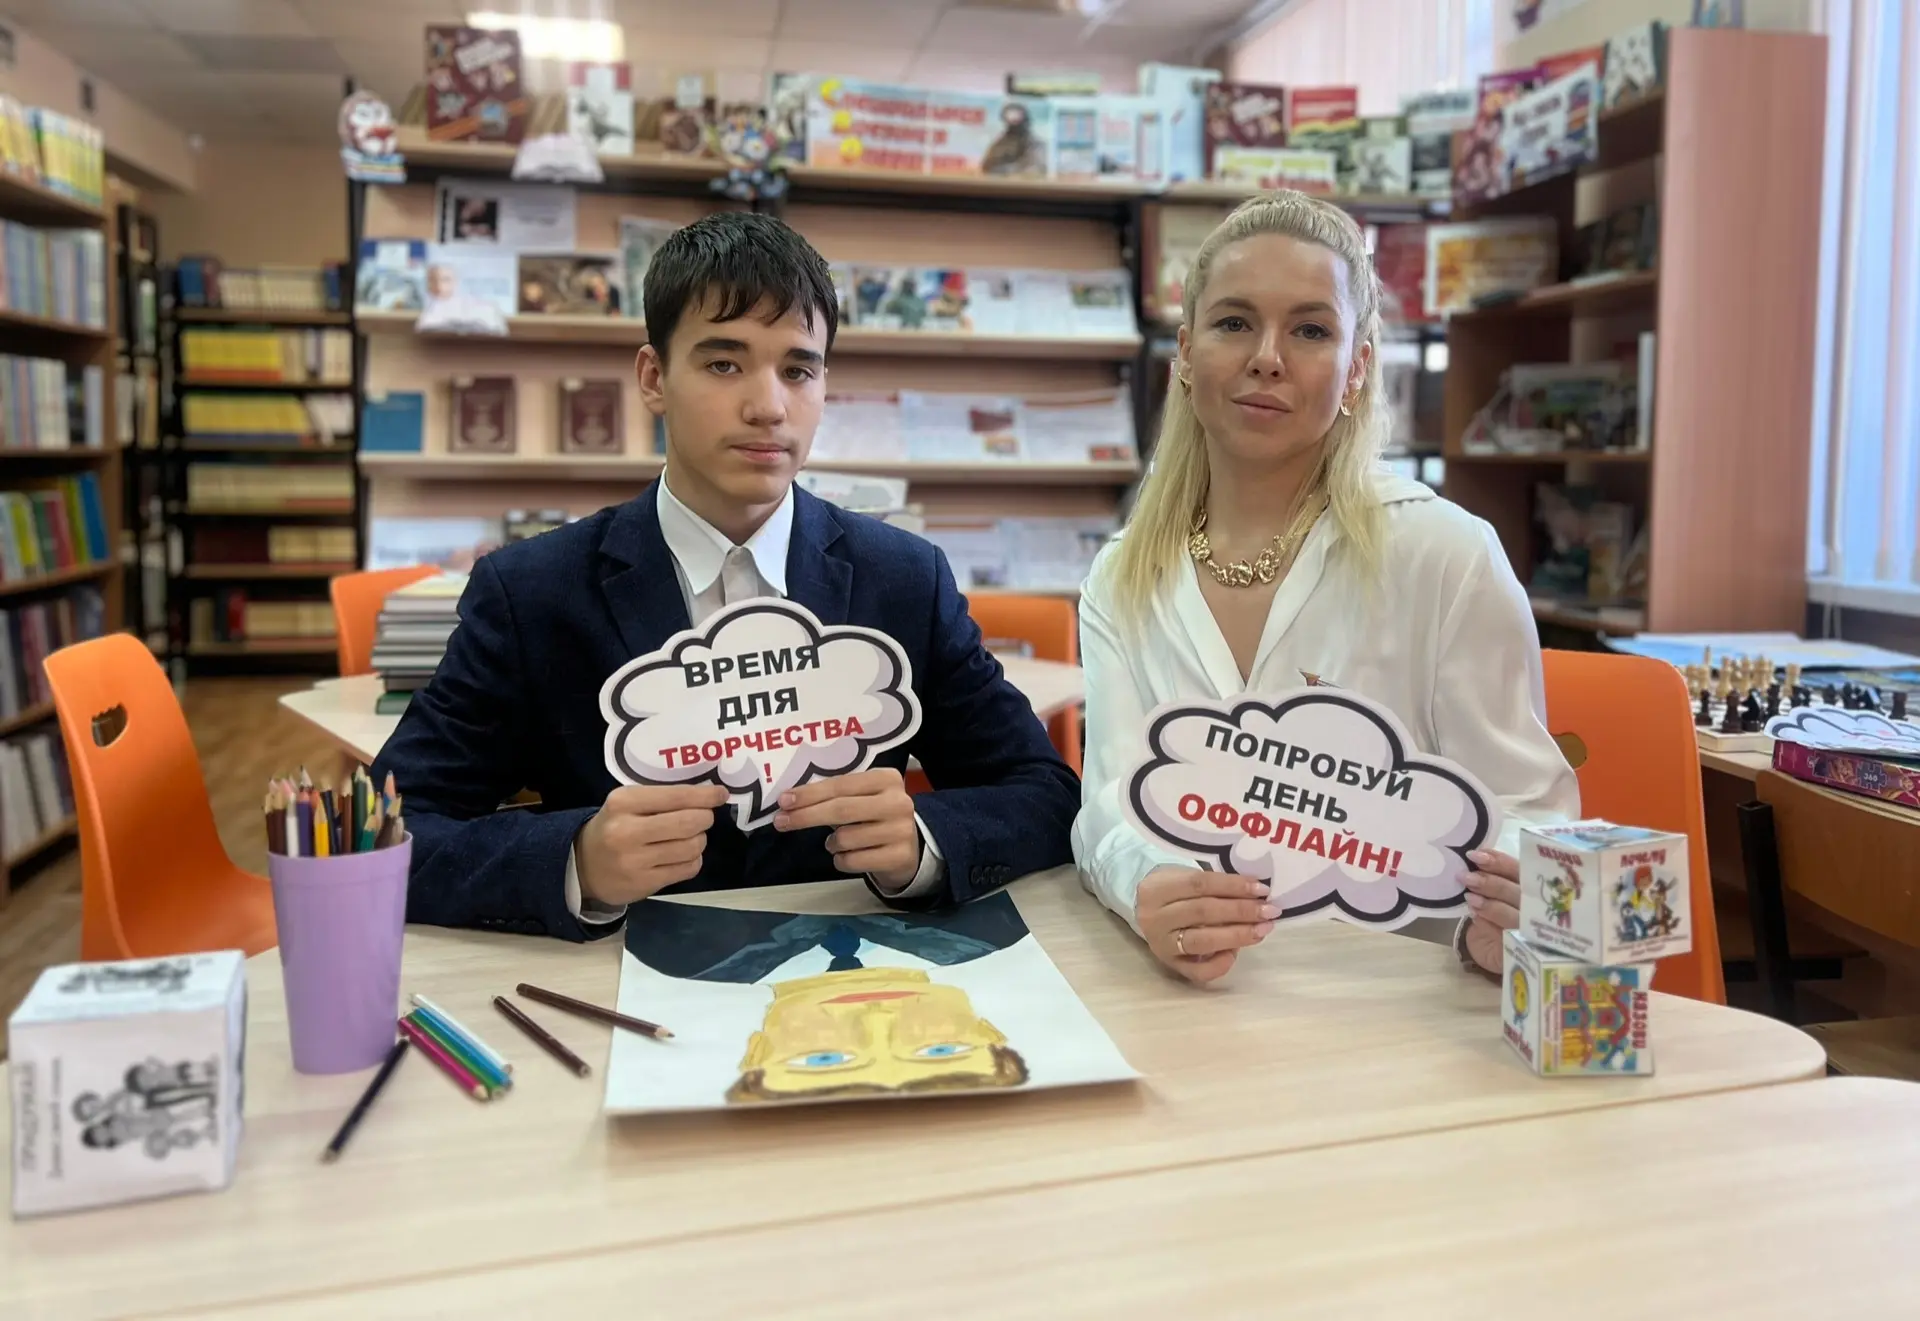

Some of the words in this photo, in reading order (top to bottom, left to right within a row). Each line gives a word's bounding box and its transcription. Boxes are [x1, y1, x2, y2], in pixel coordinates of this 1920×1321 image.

[683, 645, 821, 688] ВРЕМЯ
[717, 687, 799, 729] ДЛЯ
[658, 716, 865, 769] ТВОРЧЕСТВА
[1205, 724, 1414, 801] ПОПРОБУЙ
[763, 763, 773, 783] !
[1243, 775, 1348, 824] ДЕНЬ
[1177, 793, 1404, 878] ОФФЛАЙН!
